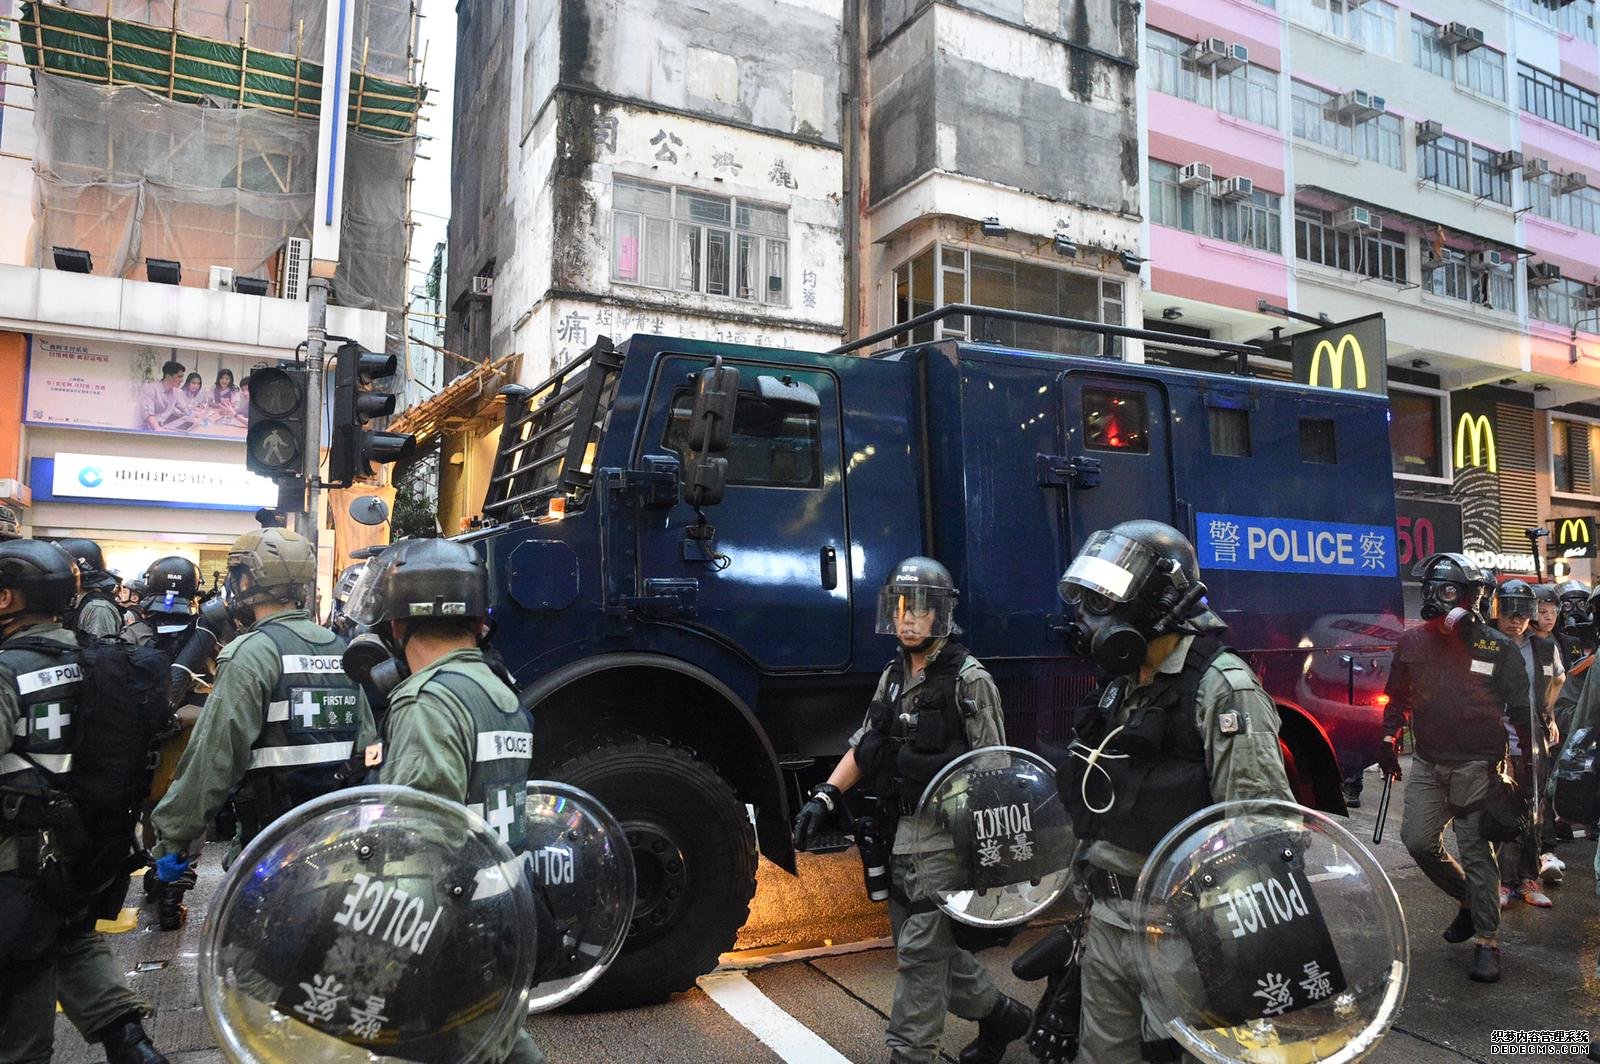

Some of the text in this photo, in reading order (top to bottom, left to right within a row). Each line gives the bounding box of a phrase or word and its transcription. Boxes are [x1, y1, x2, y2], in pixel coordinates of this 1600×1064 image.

[1209, 520, 1386, 569] 警 POLICE 察
[896, 574, 919, 582] Police
[1473, 642, 1500, 652] POLICE
[55, 666, 80, 681] POLI
[323, 696, 356, 706] FIRST AID
[974, 803, 1033, 840] POLICE
[977, 833, 1034, 867] 警察
[333, 873, 443, 954] POLICE
[1217, 872, 1309, 938] POLICE
[1252, 960, 1333, 1015] 警察
[294, 974, 389, 1040] 警察
